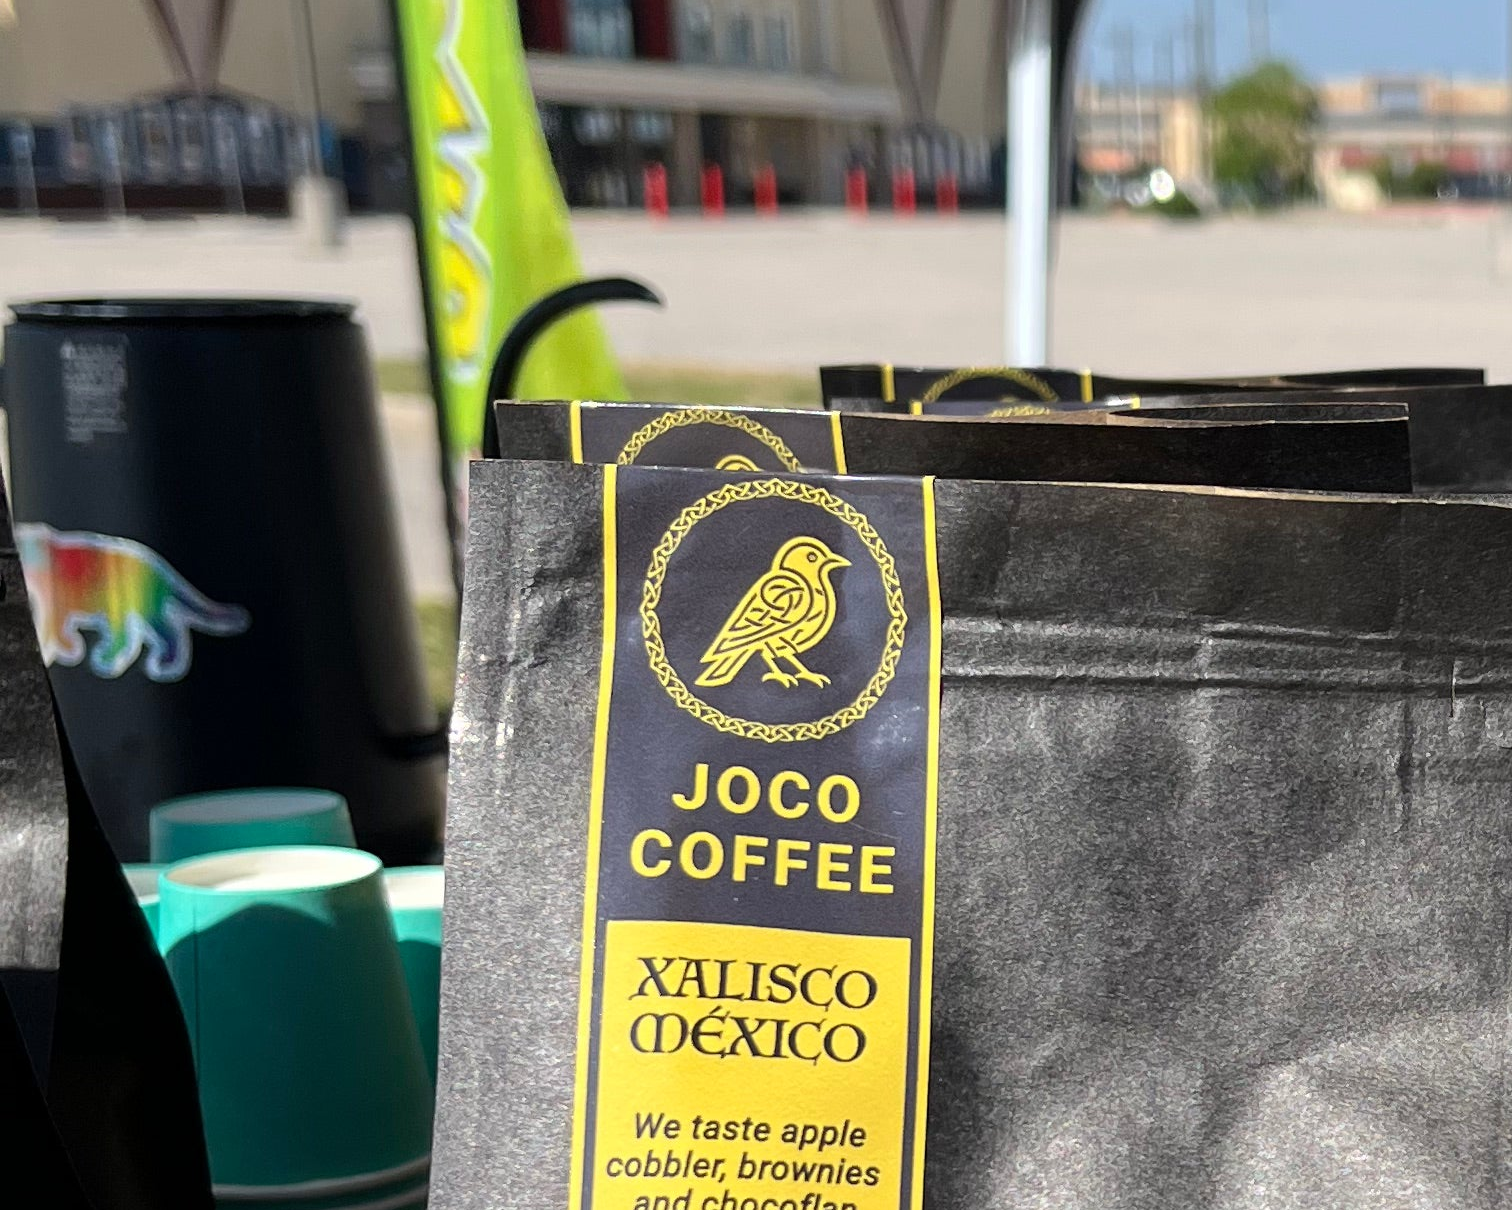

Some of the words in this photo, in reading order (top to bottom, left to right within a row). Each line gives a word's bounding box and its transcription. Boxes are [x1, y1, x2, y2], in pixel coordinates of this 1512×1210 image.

[671, 763, 861, 823] JOCO
[629, 828, 896, 894] COFFEE
[628, 956, 878, 1009] XALISCO
[629, 1005, 867, 1066] MÉXICO
[634, 1112, 681, 1140] We
[691, 1115, 771, 1142] taste
[780, 1119, 867, 1151] apple
[605, 1149, 726, 1183] cobbler,
[737, 1151, 881, 1187] brownies
